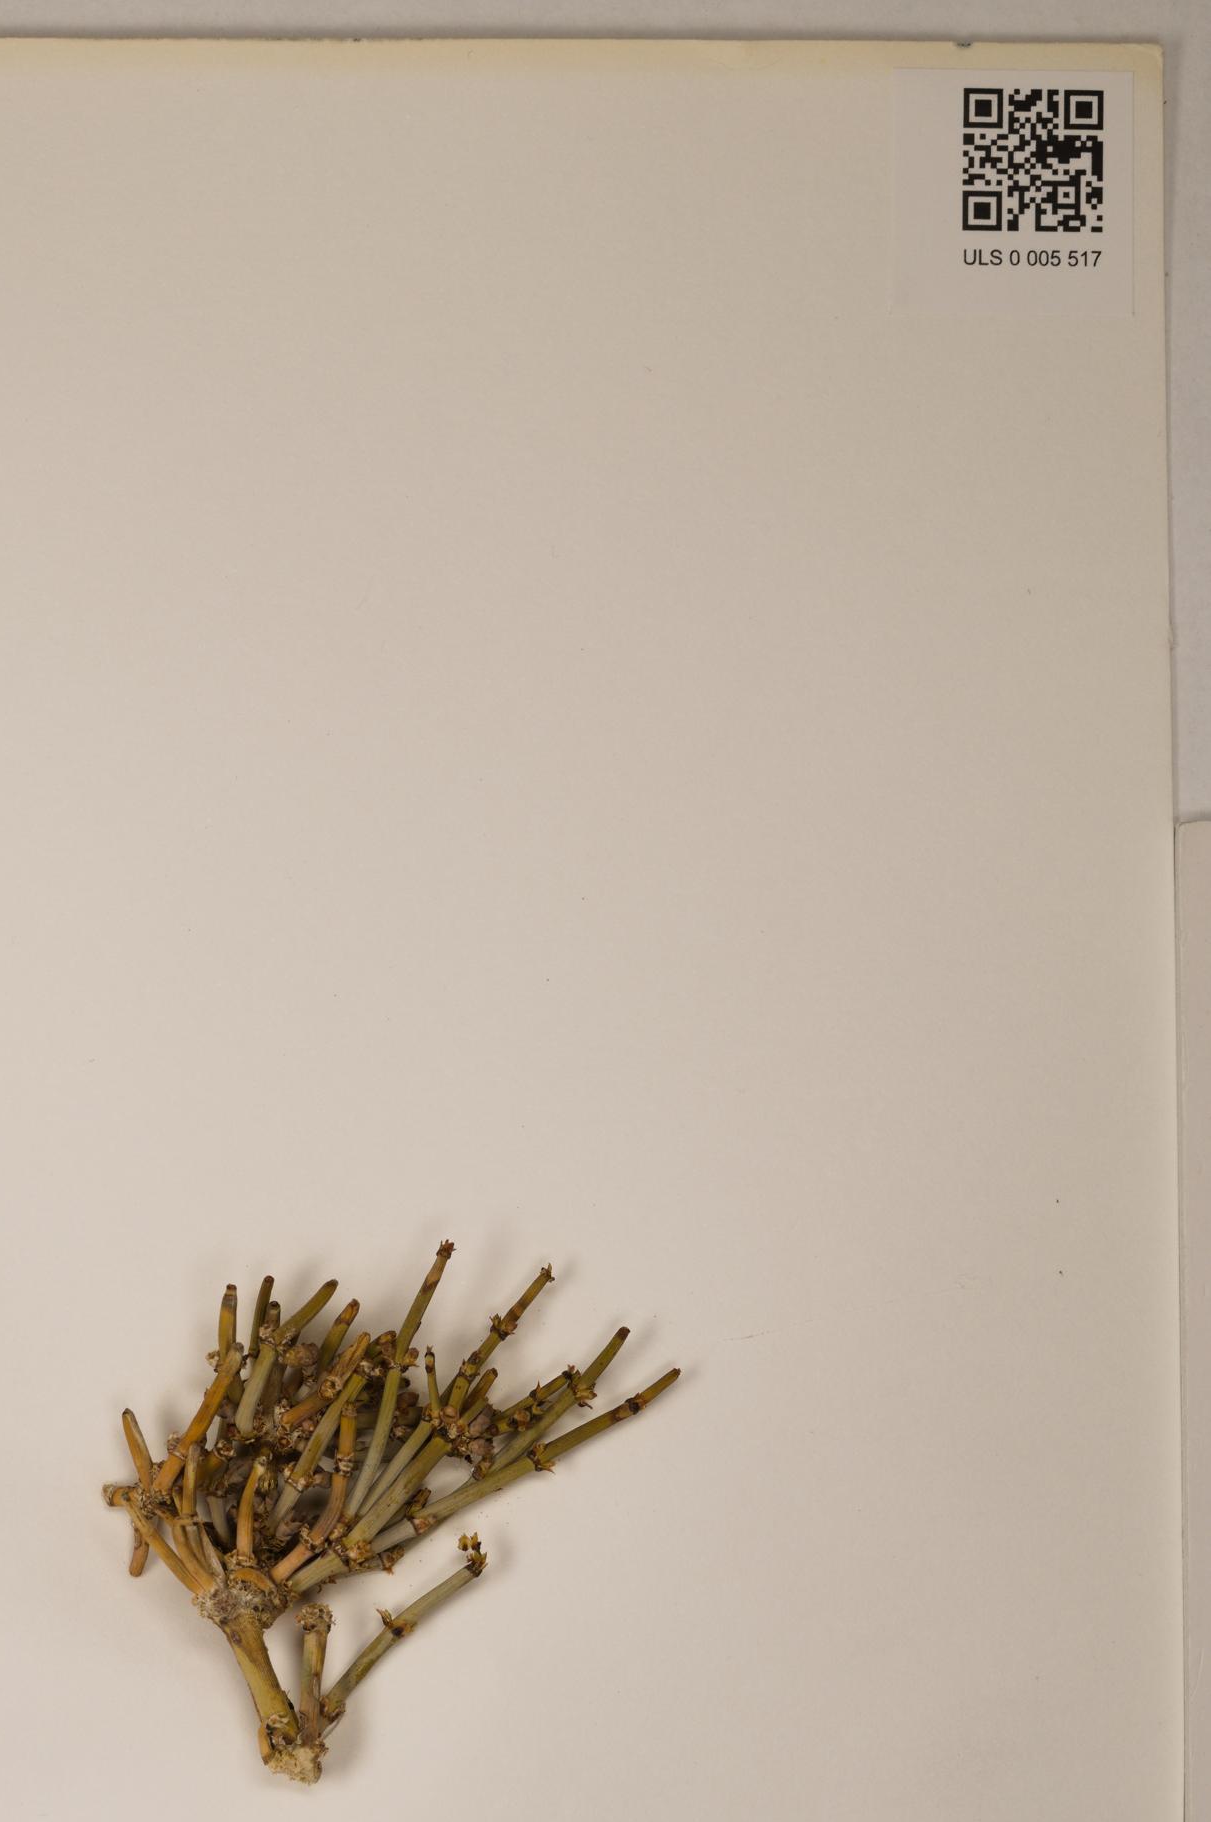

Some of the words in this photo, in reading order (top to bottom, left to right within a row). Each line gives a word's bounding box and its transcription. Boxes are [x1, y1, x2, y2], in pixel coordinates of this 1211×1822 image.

[963, 249, 1003, 267] ULS
[1009, 249, 1021, 267] 0
[1026, 249, 1062, 267] 005
[1067, 249, 1102, 268] 517
